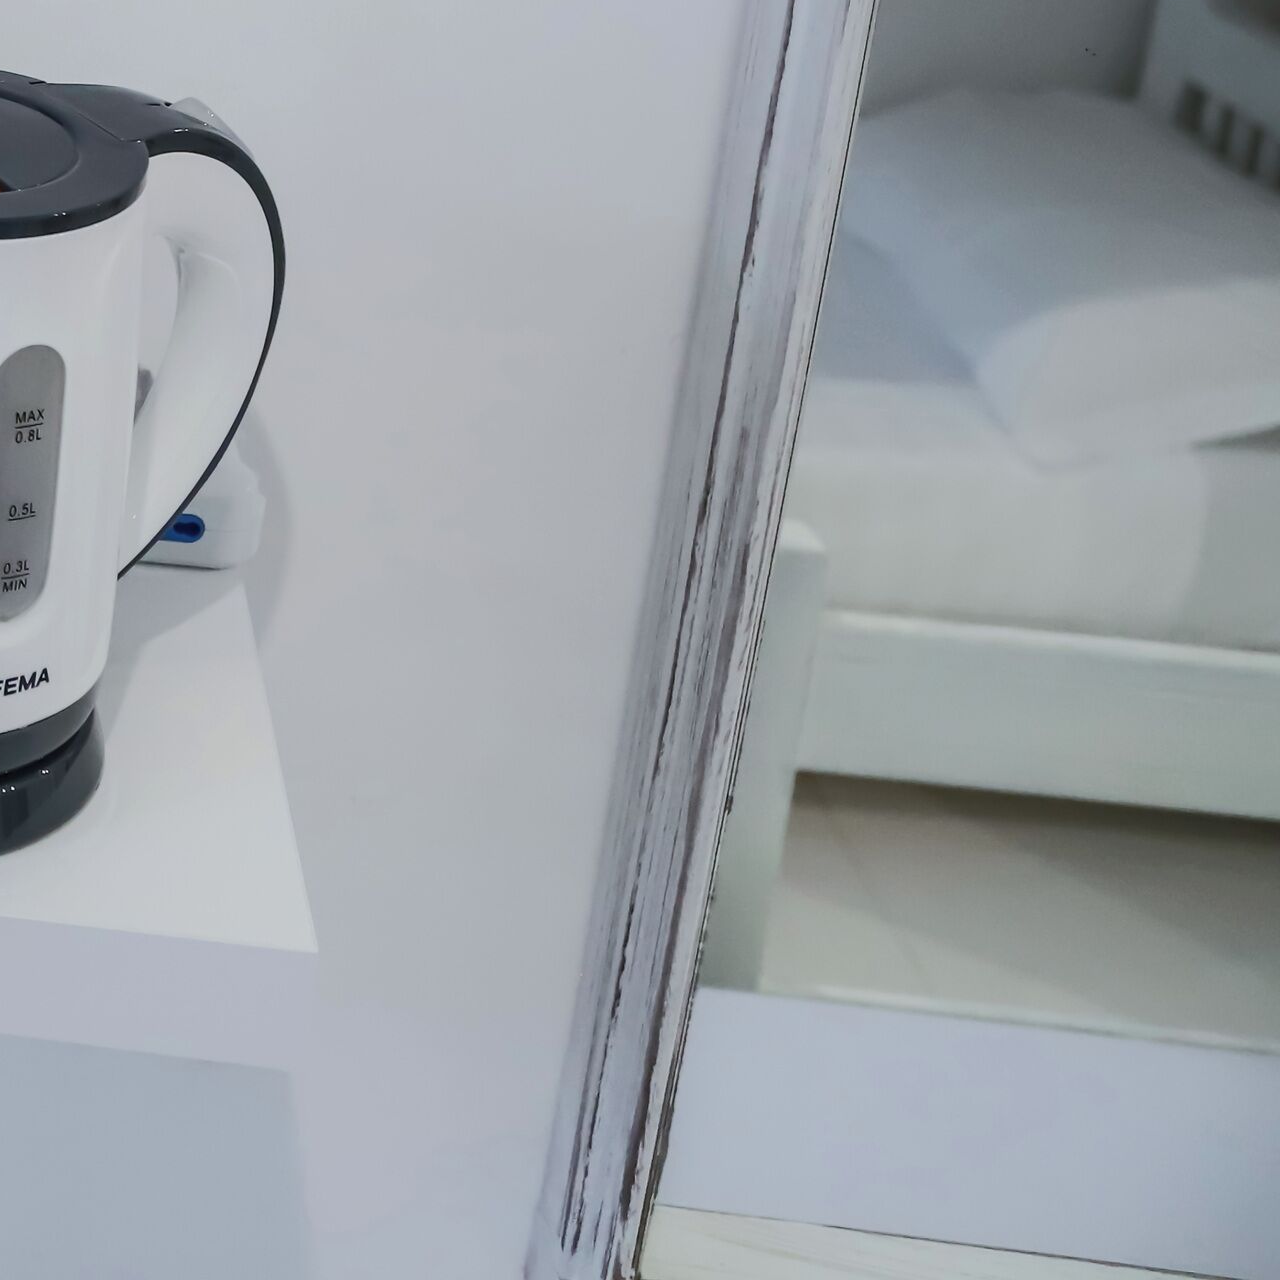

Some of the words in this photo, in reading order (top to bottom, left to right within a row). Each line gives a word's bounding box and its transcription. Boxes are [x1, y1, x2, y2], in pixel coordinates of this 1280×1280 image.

[15, 408, 45, 424] MAX
[15, 428, 42, 444] 0.8L
[8, 502, 36, 518] 0.5L
[3, 560, 30, 575] 0.3L
[2, 579, 28, 593] MIN
